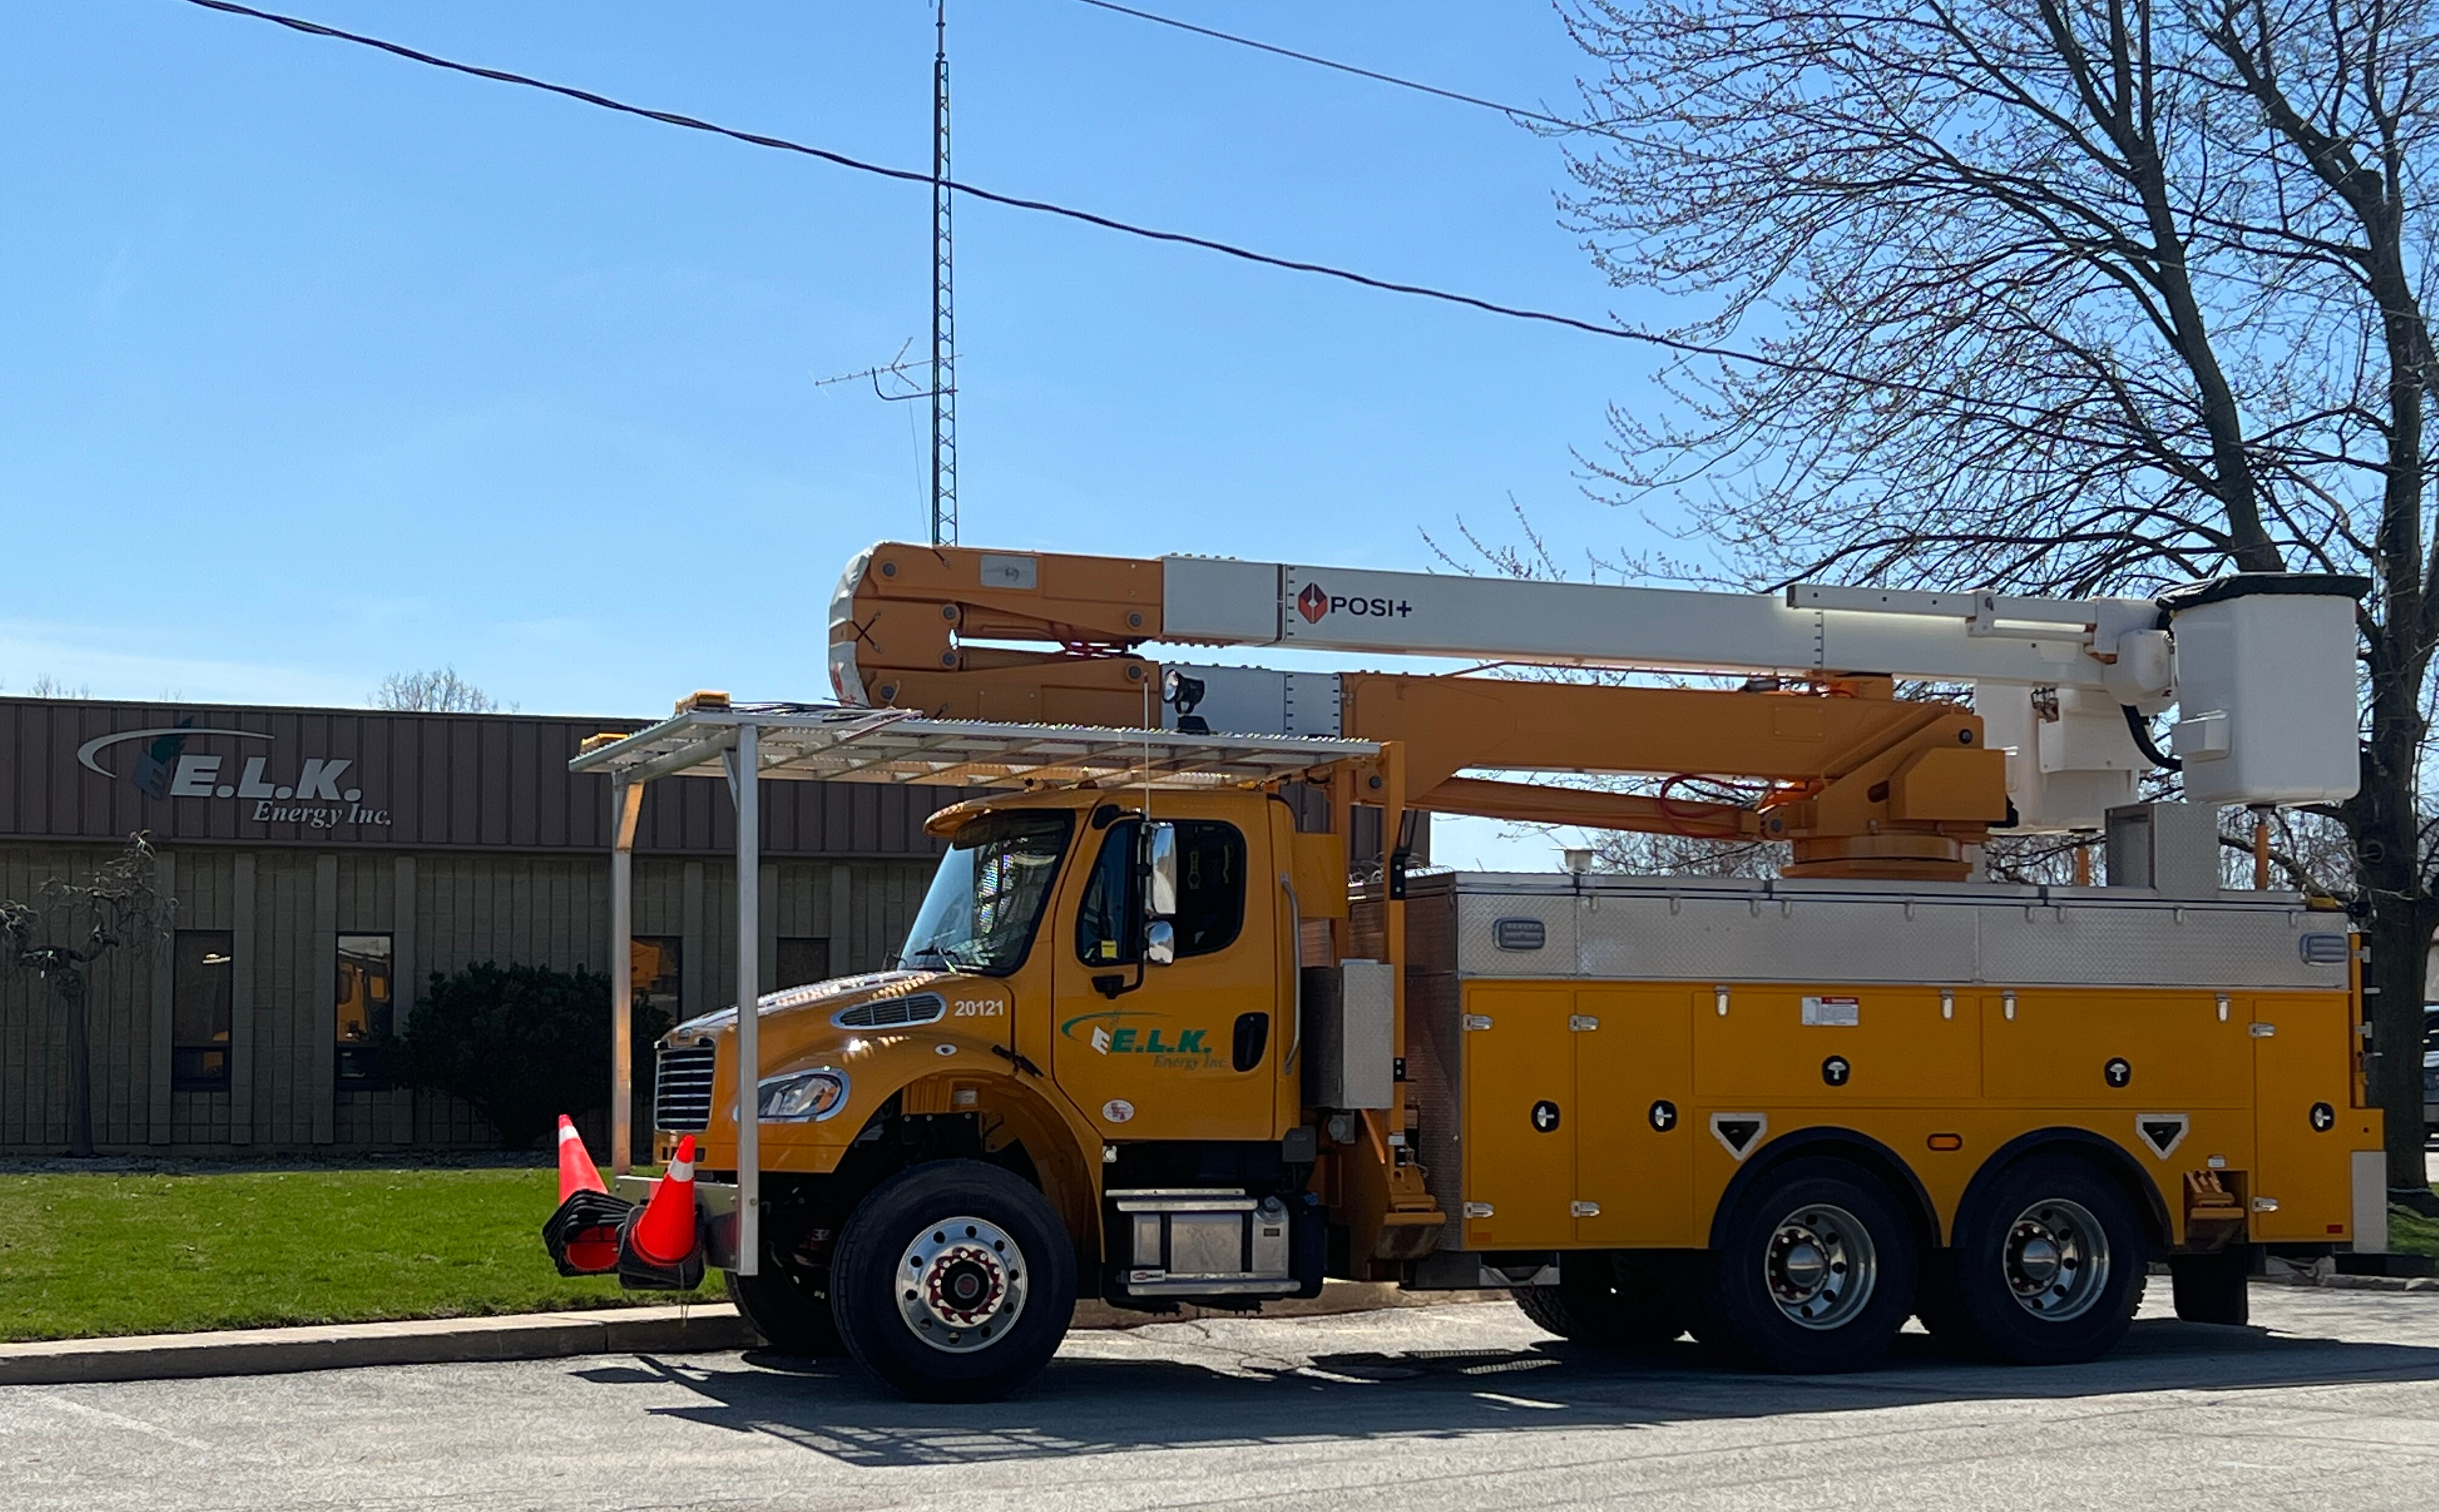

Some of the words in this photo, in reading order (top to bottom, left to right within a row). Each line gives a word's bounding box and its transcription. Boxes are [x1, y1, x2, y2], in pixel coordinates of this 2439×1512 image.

[1331, 596, 1412, 618] POSI+
[170, 755, 362, 801] E.L.K.
[252, 800, 342, 828] Energy
[348, 803, 392, 826] Inc.
[955, 1000, 1004, 1016] 20121
[1111, 1029, 1212, 1053] E.L.K.
